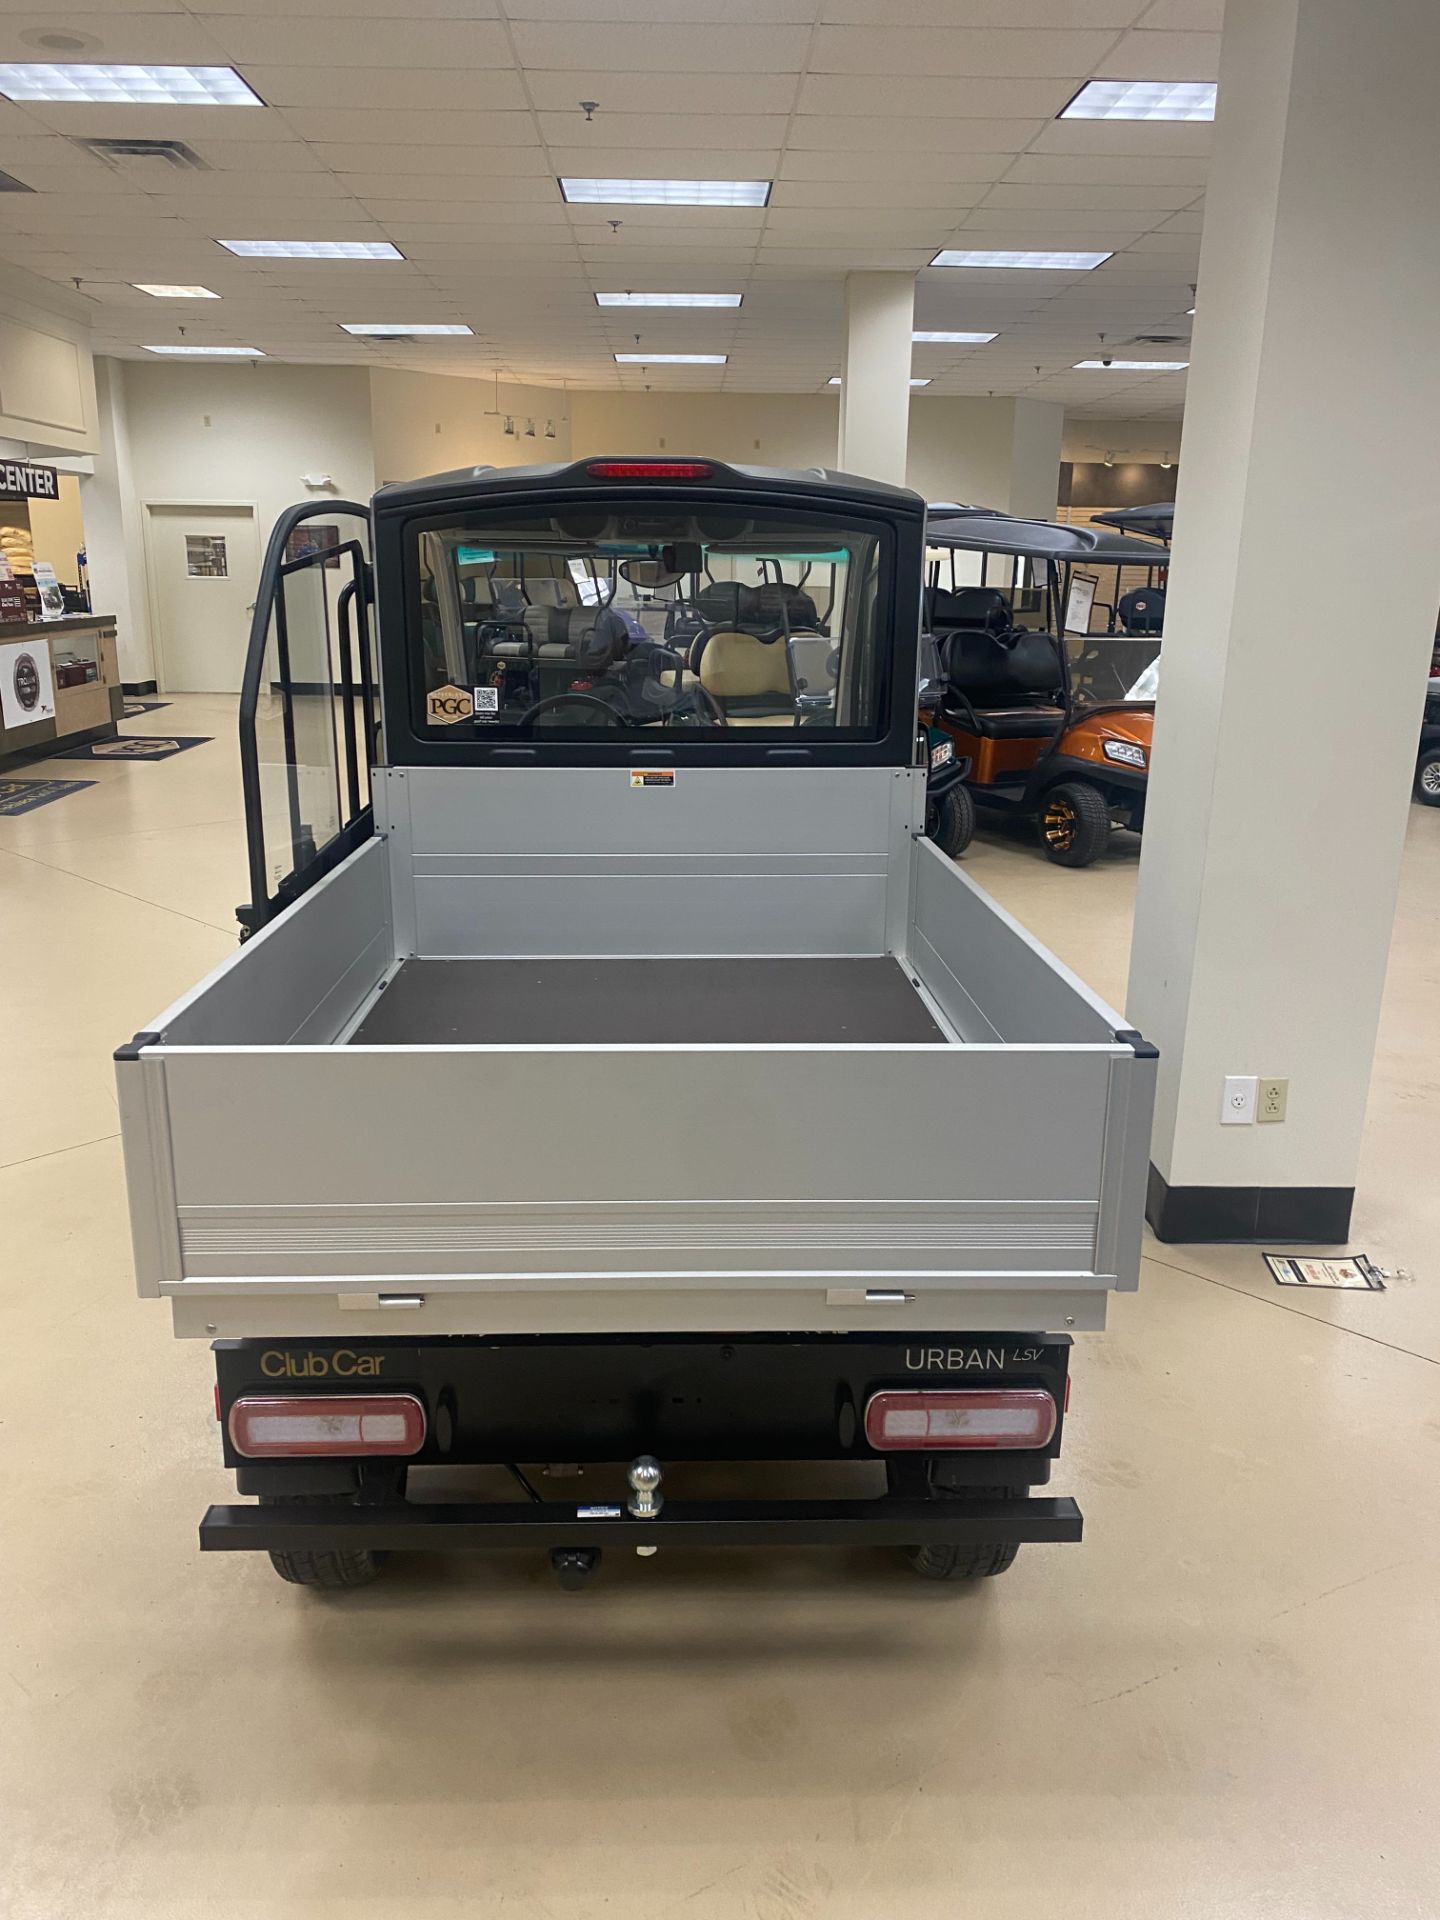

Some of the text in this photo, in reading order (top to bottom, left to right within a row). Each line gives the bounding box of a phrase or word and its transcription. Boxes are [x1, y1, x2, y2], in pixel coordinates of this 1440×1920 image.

[0, 464, 55, 495] CENTER
[429, 698, 471, 715] PGC
[260, 1349, 385, 1377] Club Car
[906, 1348, 1044, 1370] URBAN LSV
